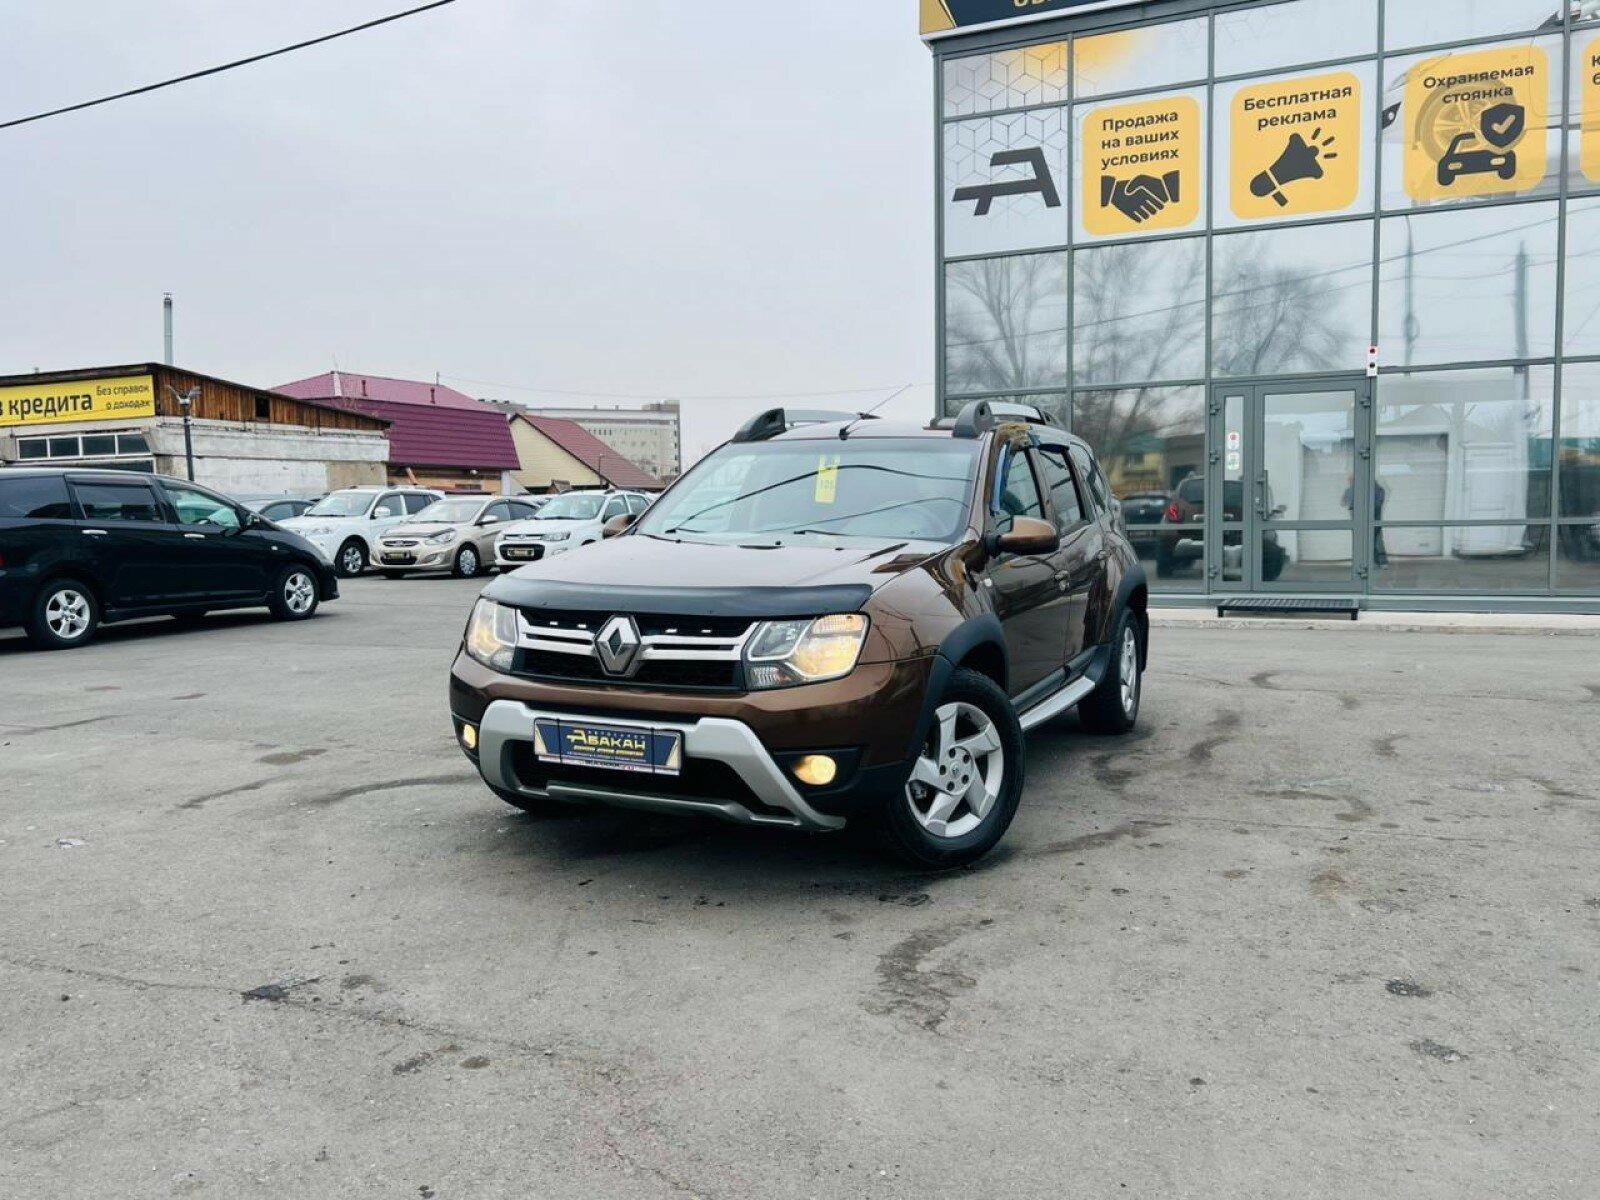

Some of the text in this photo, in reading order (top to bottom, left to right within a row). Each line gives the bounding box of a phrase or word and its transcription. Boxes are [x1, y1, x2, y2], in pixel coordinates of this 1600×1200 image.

[1423, 65, 1535, 89] Охраняемая
[1244, 86, 1352, 111] Бесплатная
[1442, 86, 1513, 104] стоянка
[1102, 111, 1179, 132] Продажа
[1258, 108, 1337, 131] реклама
[1101, 130, 1180, 150] на ваших
[1101, 149, 1179, 170] условиях
[9, 393, 92, 420] кредита
